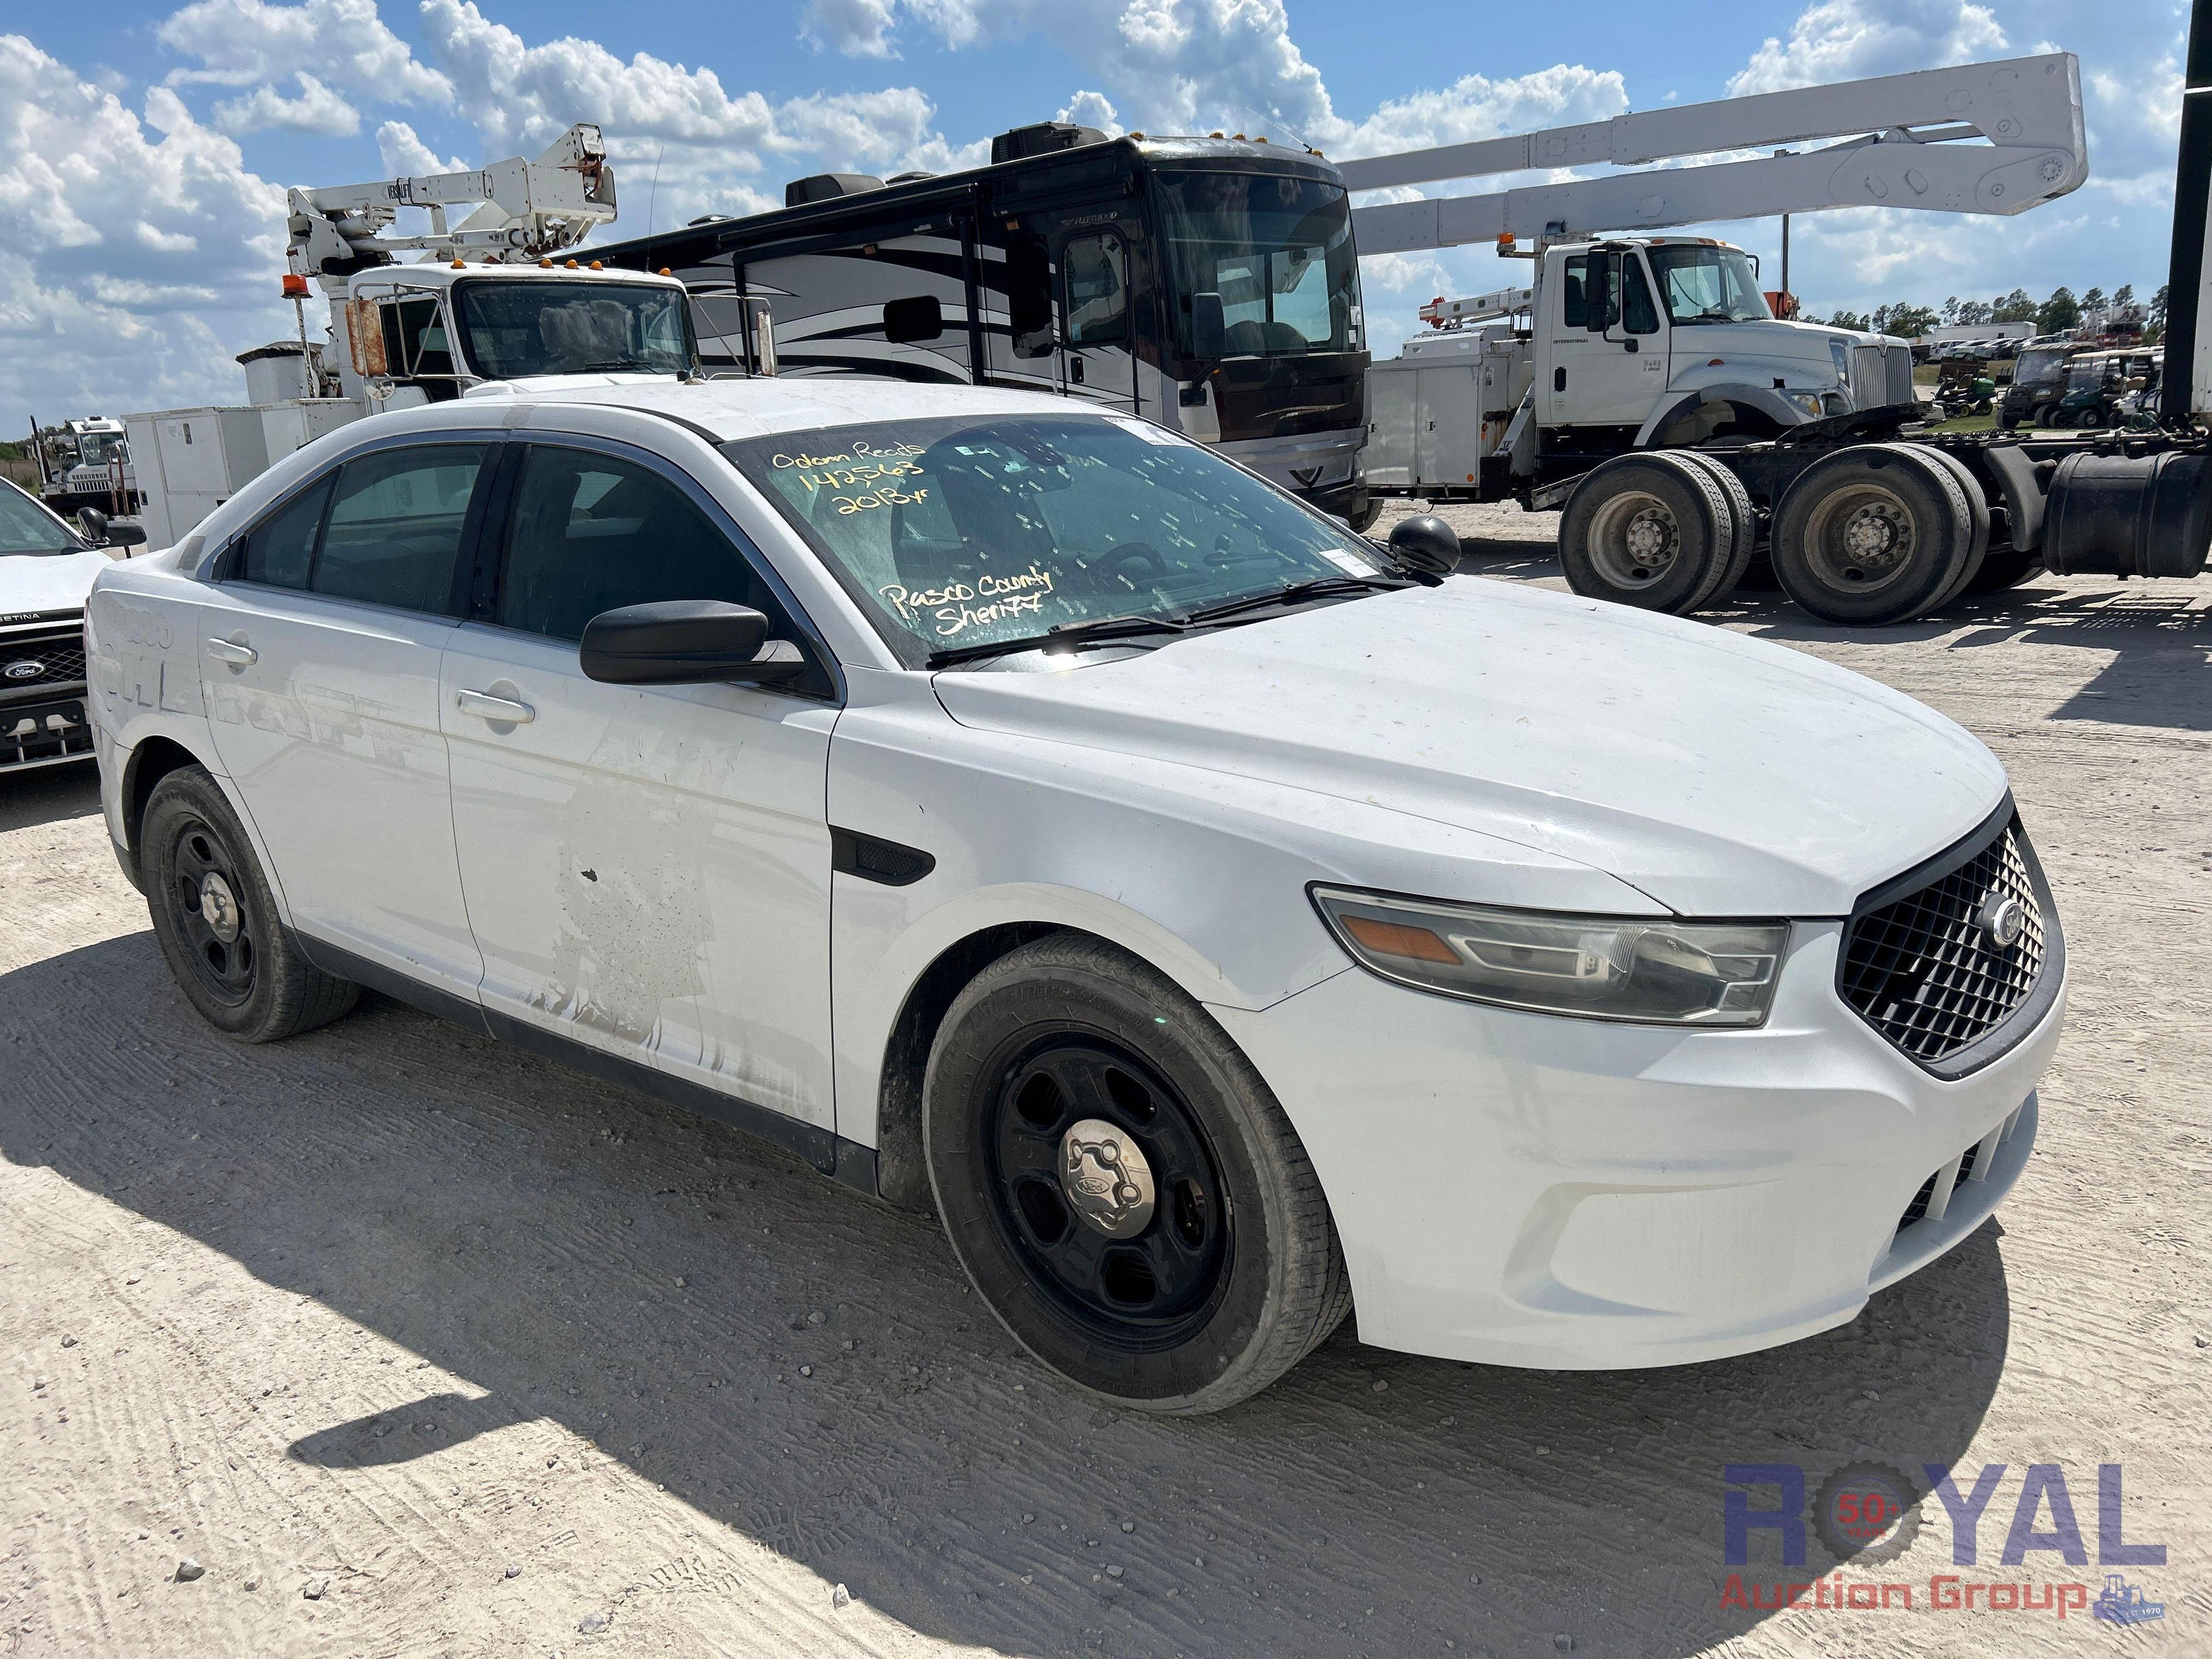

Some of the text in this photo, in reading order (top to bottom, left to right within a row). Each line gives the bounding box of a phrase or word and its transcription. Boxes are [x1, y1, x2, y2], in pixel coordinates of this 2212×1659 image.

[1075, 211, 1117, 225] FLEETWOOD
[852, 441, 926, 460] Reads
[798, 461, 924, 491] 142,563
[878, 565, 1054, 622] Pasco County
[15, 666, 36, 676] Ford
[2006, 910, 2021, 938] Ford
[1082, 1179, 1104, 1192] Ford
